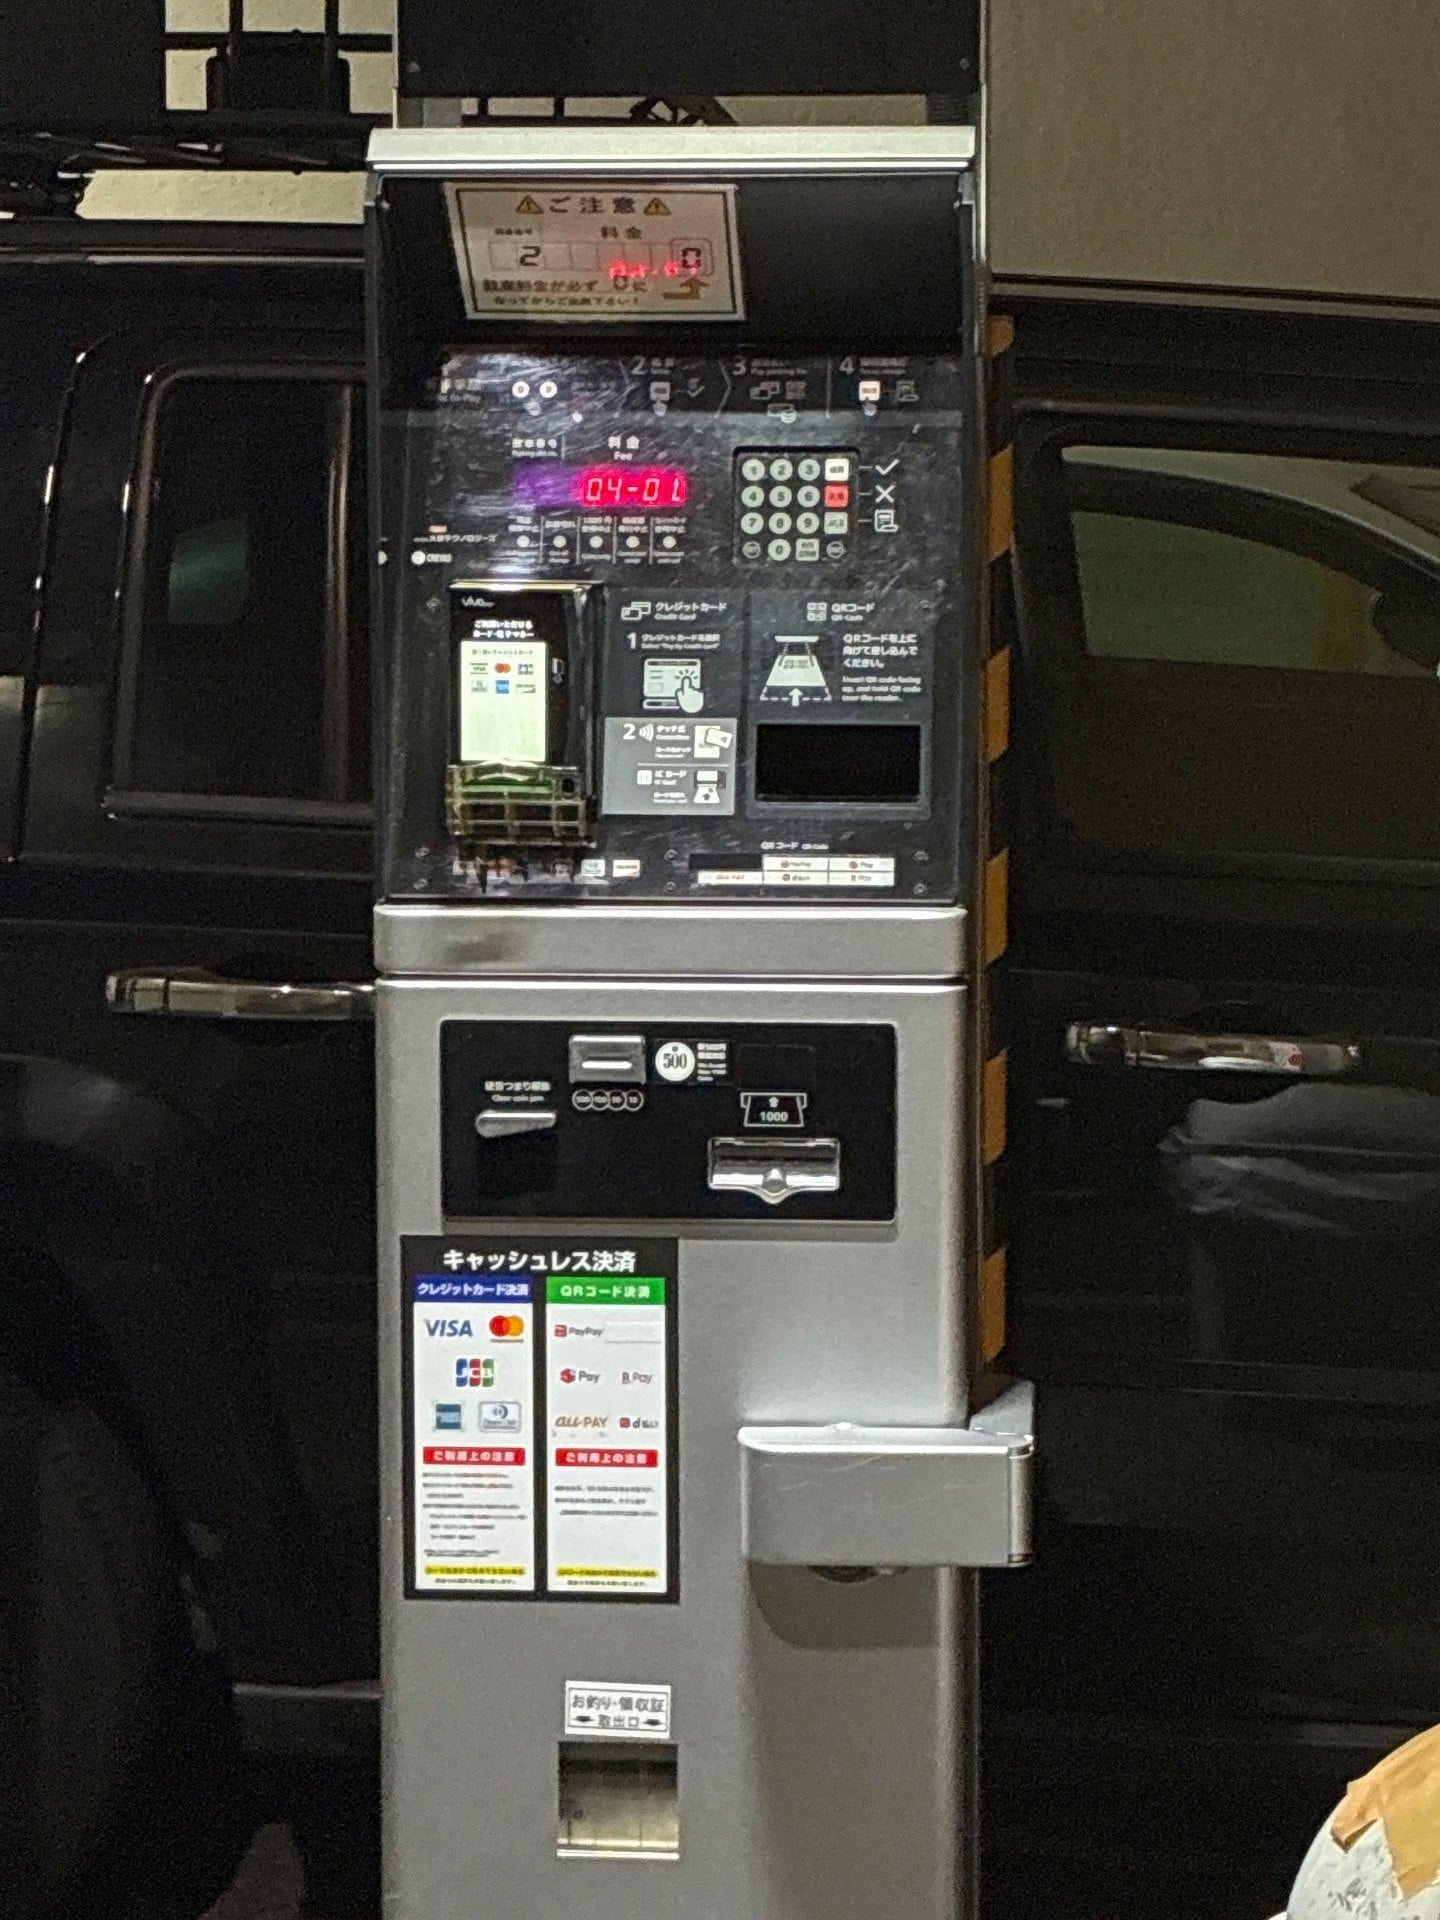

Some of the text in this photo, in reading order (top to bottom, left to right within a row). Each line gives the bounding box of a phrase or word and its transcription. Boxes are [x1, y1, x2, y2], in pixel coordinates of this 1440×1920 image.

[549, 196, 636, 214] ご注意
[601, 226, 642, 239] 料金
[519, 245, 541, 267] 2
[733, 357, 746, 375] 3
[614, 452, 633, 461] Fee
[777, 465, 786, 476] 2
[805, 465, 813, 475] 3
[748, 491, 813, 502] 4 5 6
[748, 518, 812, 528] 7 8 9
[655, 602, 728, 612] クレジットカード
[831, 603, 875, 613] QRコード
[627, 632, 637, 650] 1
[622, 723, 636, 740] 2
[663, 1052, 688, 1069] 500
[759, 1111, 789, 1122] 1000
[443, 1249, 637, 1273] キャッシュレス決済
[417, 1283, 530, 1297] クレジットカード決済
[560, 1286, 651, 1299] QRコード決済
[424, 1319, 473, 1337] VISA
[569, 1326, 603, 1338] PayPay
[578, 1370, 600, 1383] Pay
[632, 1371, 653, 1384] Pay
[583, 1416, 608, 1427] PAY
[598, 1714, 640, 1728] 取出口
